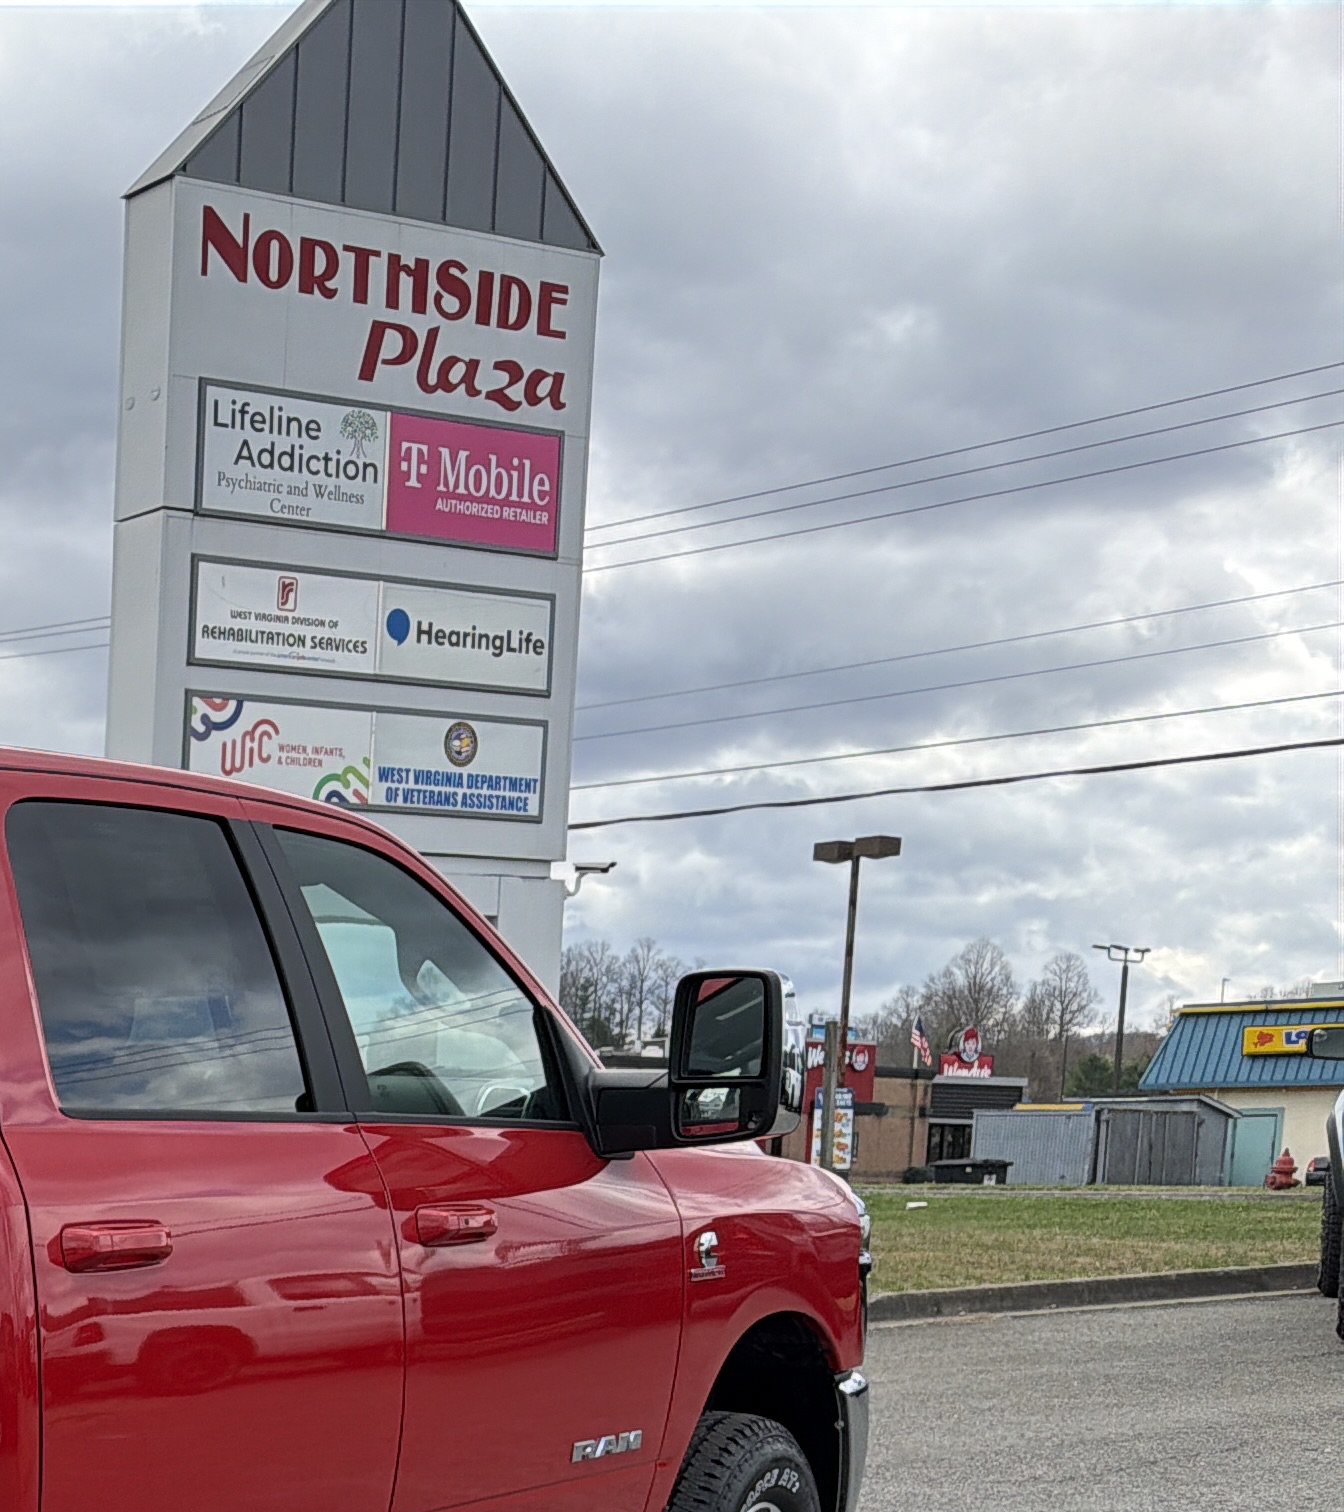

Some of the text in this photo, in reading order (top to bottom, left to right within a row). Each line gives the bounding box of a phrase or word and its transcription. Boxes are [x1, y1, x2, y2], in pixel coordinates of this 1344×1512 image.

[201, 205, 569, 339] NORTHSIDE
[357, 319, 567, 412] Plaza
[212, 398, 322, 441] Lifeline
[233, 438, 379, 484] Addiction
[217, 470, 365, 505] Psychiatric and Wellness
[269, 497, 312, 518] Center
[435, 497, 549, 525] AUTHORIZED RETAILER
[230, 609, 339, 630] WEST VIRGINIA DIVISION OF
[201, 624, 368, 655] REHABILITATION SERVICES
[416, 620, 545, 657] HearingLife
[277, 743, 346, 760] WOMEN, INFANTS,
[277, 756, 323, 768] & CHILDREN
[378, 765, 539, 795] WEST VIRGINIA DEPARTMENT
[385, 786, 529, 813] OF VETERANS ASSISTANCE
[572, 1429, 643, 1464] RAM
